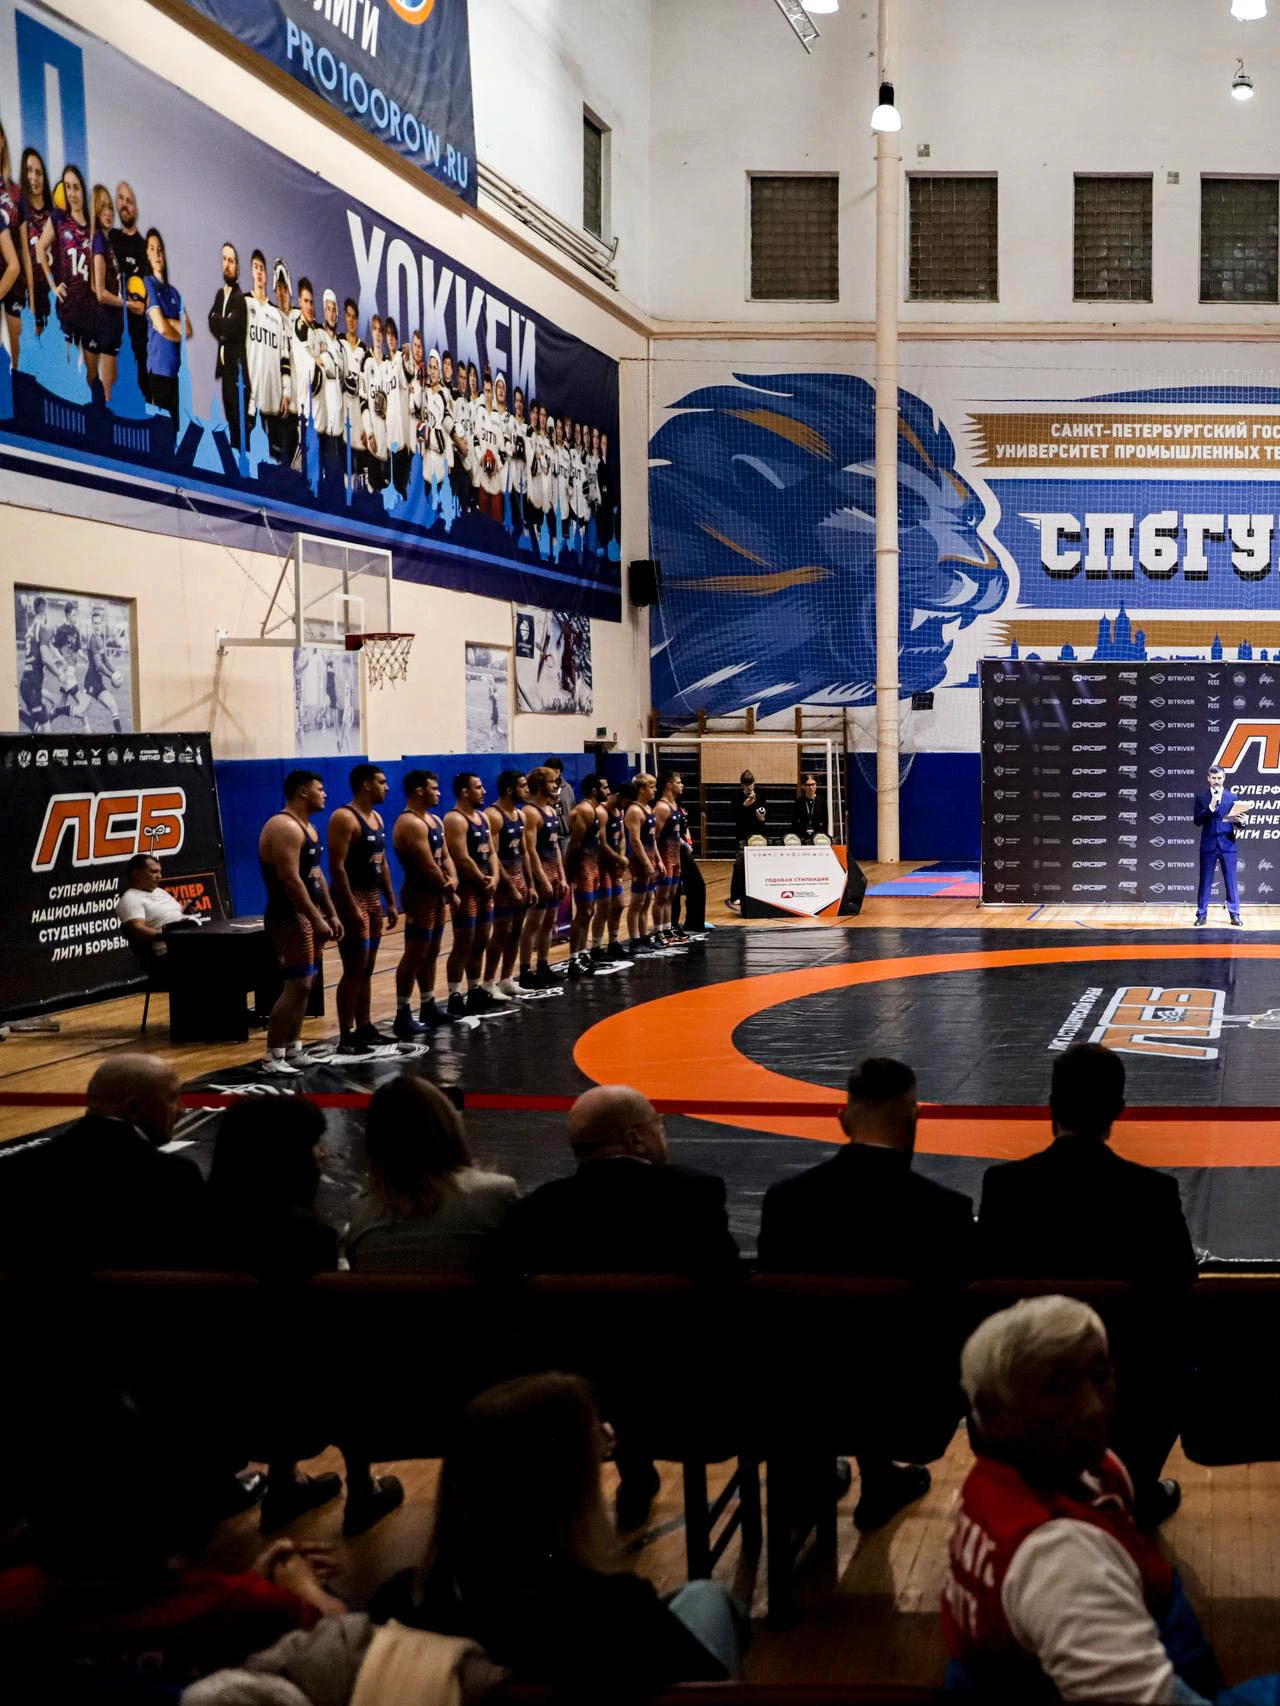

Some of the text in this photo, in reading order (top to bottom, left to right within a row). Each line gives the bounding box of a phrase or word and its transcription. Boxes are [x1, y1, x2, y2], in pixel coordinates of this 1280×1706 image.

[67, 247, 89, 281] 14
[250, 324, 278, 349] GUTID
[1051, 421, 1248, 439] САНКТ-ПЕТЕРБУРГСКИЙ
[996, 444, 1109, 459] УНИВЕРСИТЕТ
[1114, 445, 1260, 460] ПРОМЫШЛЕННЫХ
[32, 787, 186, 872] ЛСБ
[1233, 830, 1260, 839] ИГИ
[49, 878, 119, 900] СУПЕРФИНАЛ
[31, 893, 121, 924] НАЦИОНАЛЬНОЙ
[51, 944, 83, 962] ЛИГИ
